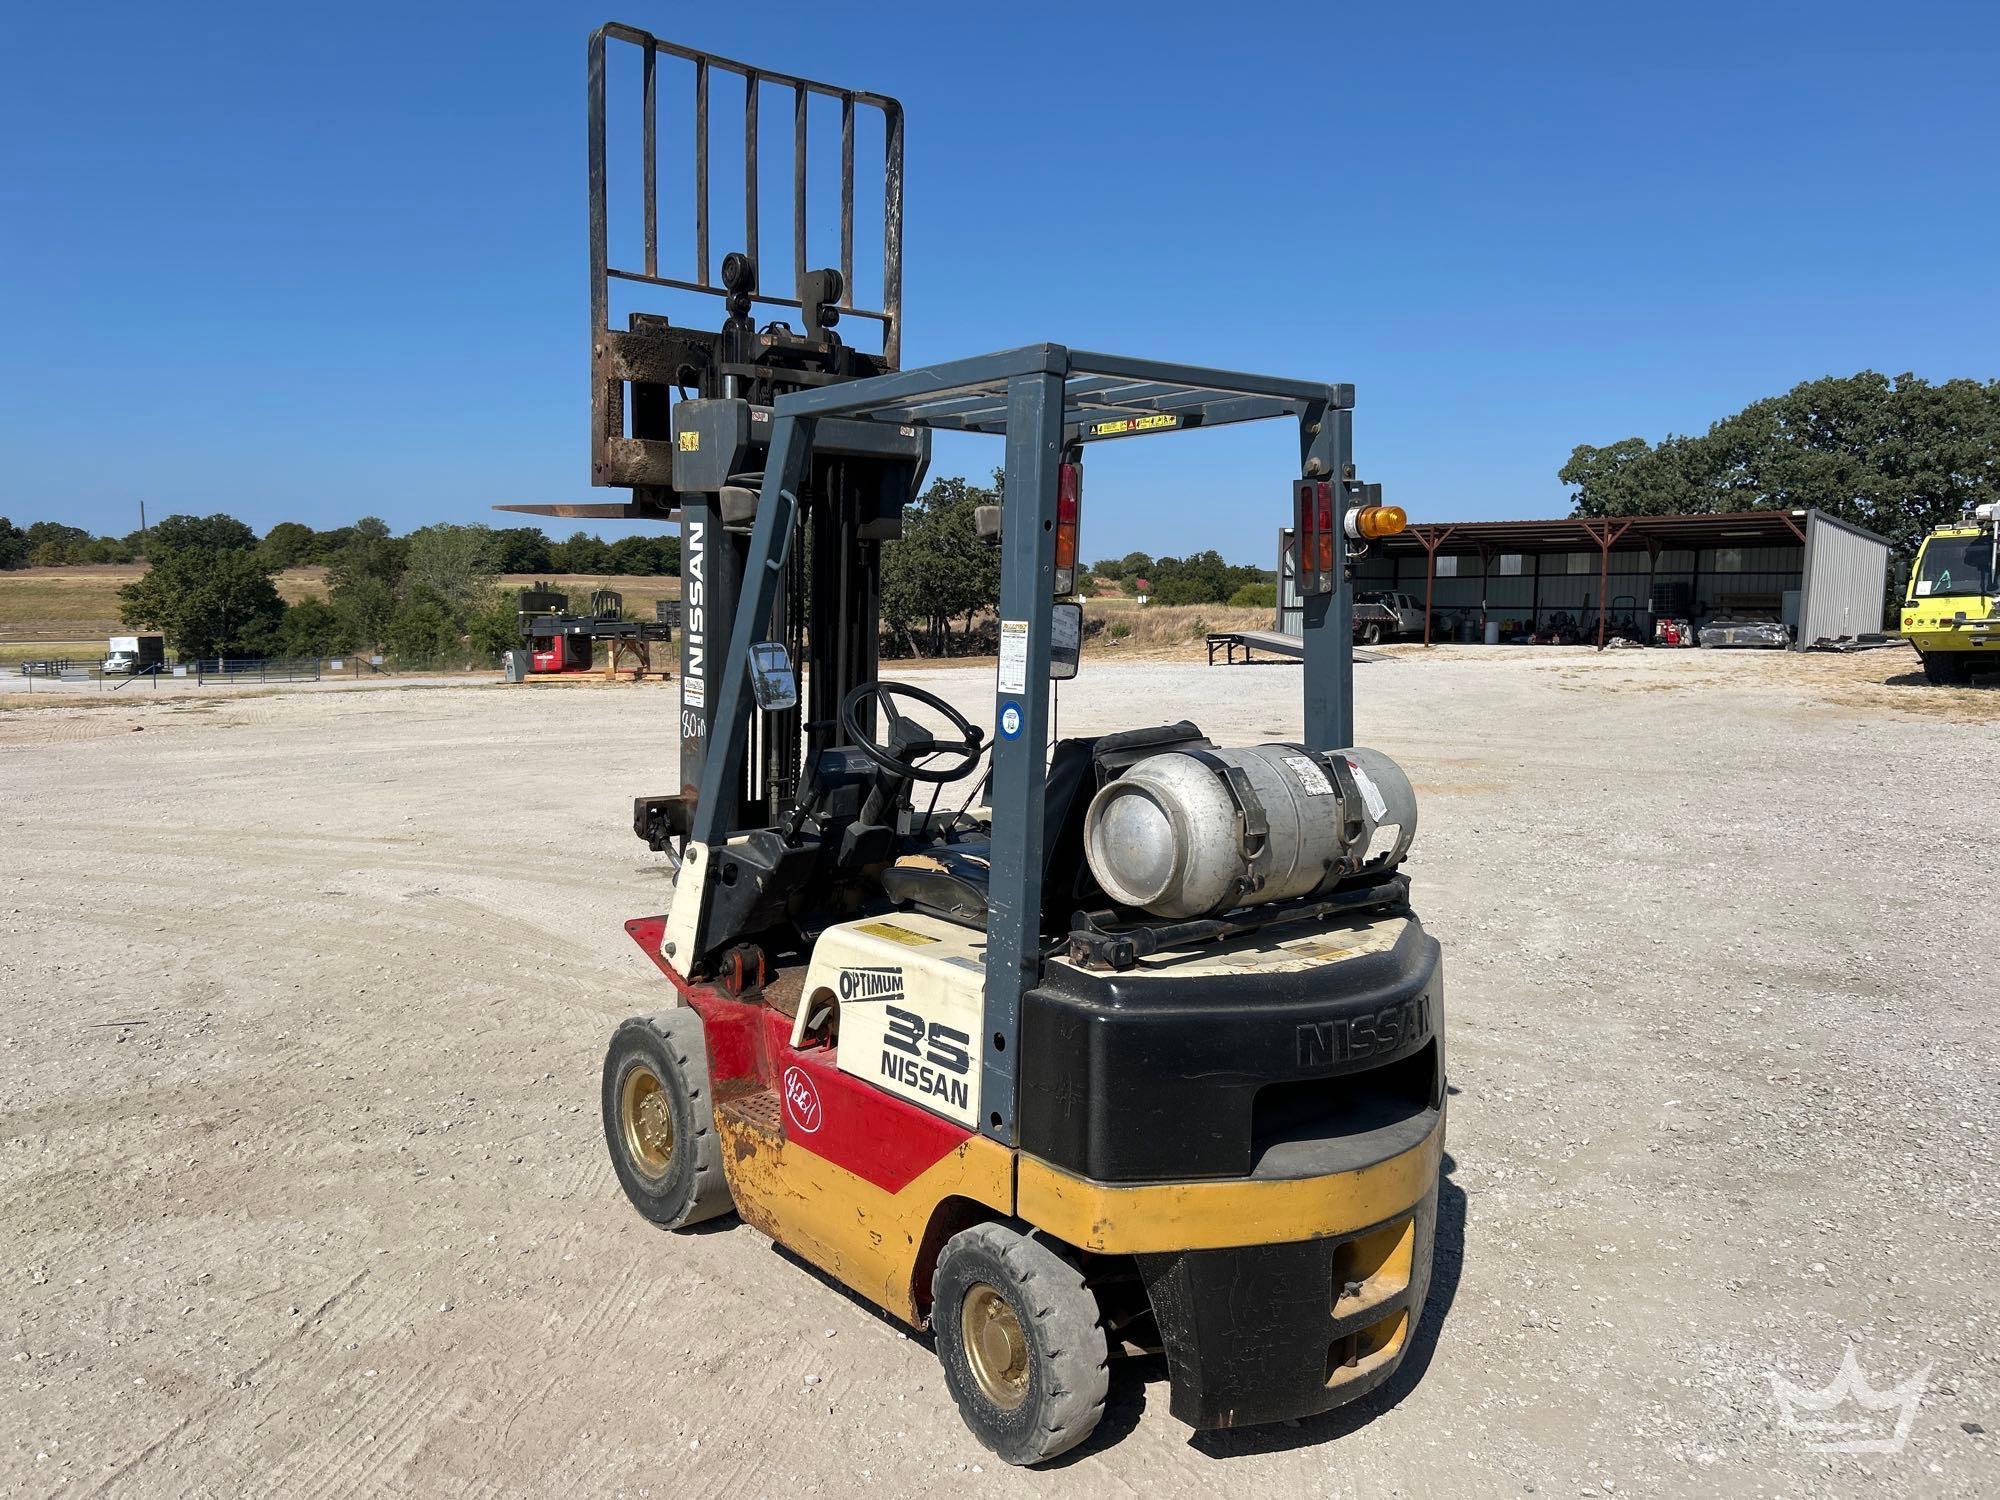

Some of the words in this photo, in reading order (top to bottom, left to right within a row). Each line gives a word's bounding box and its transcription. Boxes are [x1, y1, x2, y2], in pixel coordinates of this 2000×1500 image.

[689, 522, 704, 676] NISSAN
[839, 970, 904, 1000] OPTIMUM
[1296, 994, 1431, 1067] NISSAN
[881, 1050, 969, 1110] NISSAN
